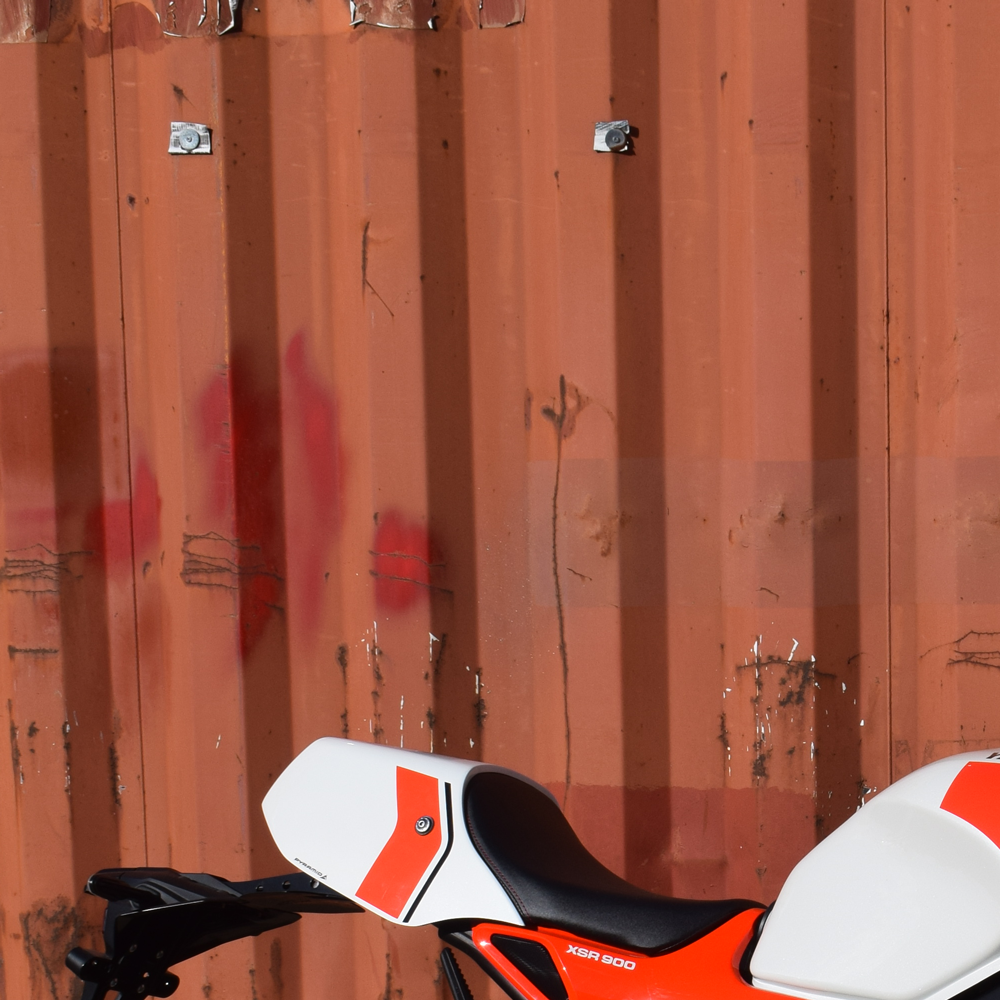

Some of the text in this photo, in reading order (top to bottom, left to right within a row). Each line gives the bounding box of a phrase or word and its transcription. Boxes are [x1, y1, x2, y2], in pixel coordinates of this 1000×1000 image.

[294, 857, 327, 880] PYRAMID
[565, 944, 637, 971] XSR 900
